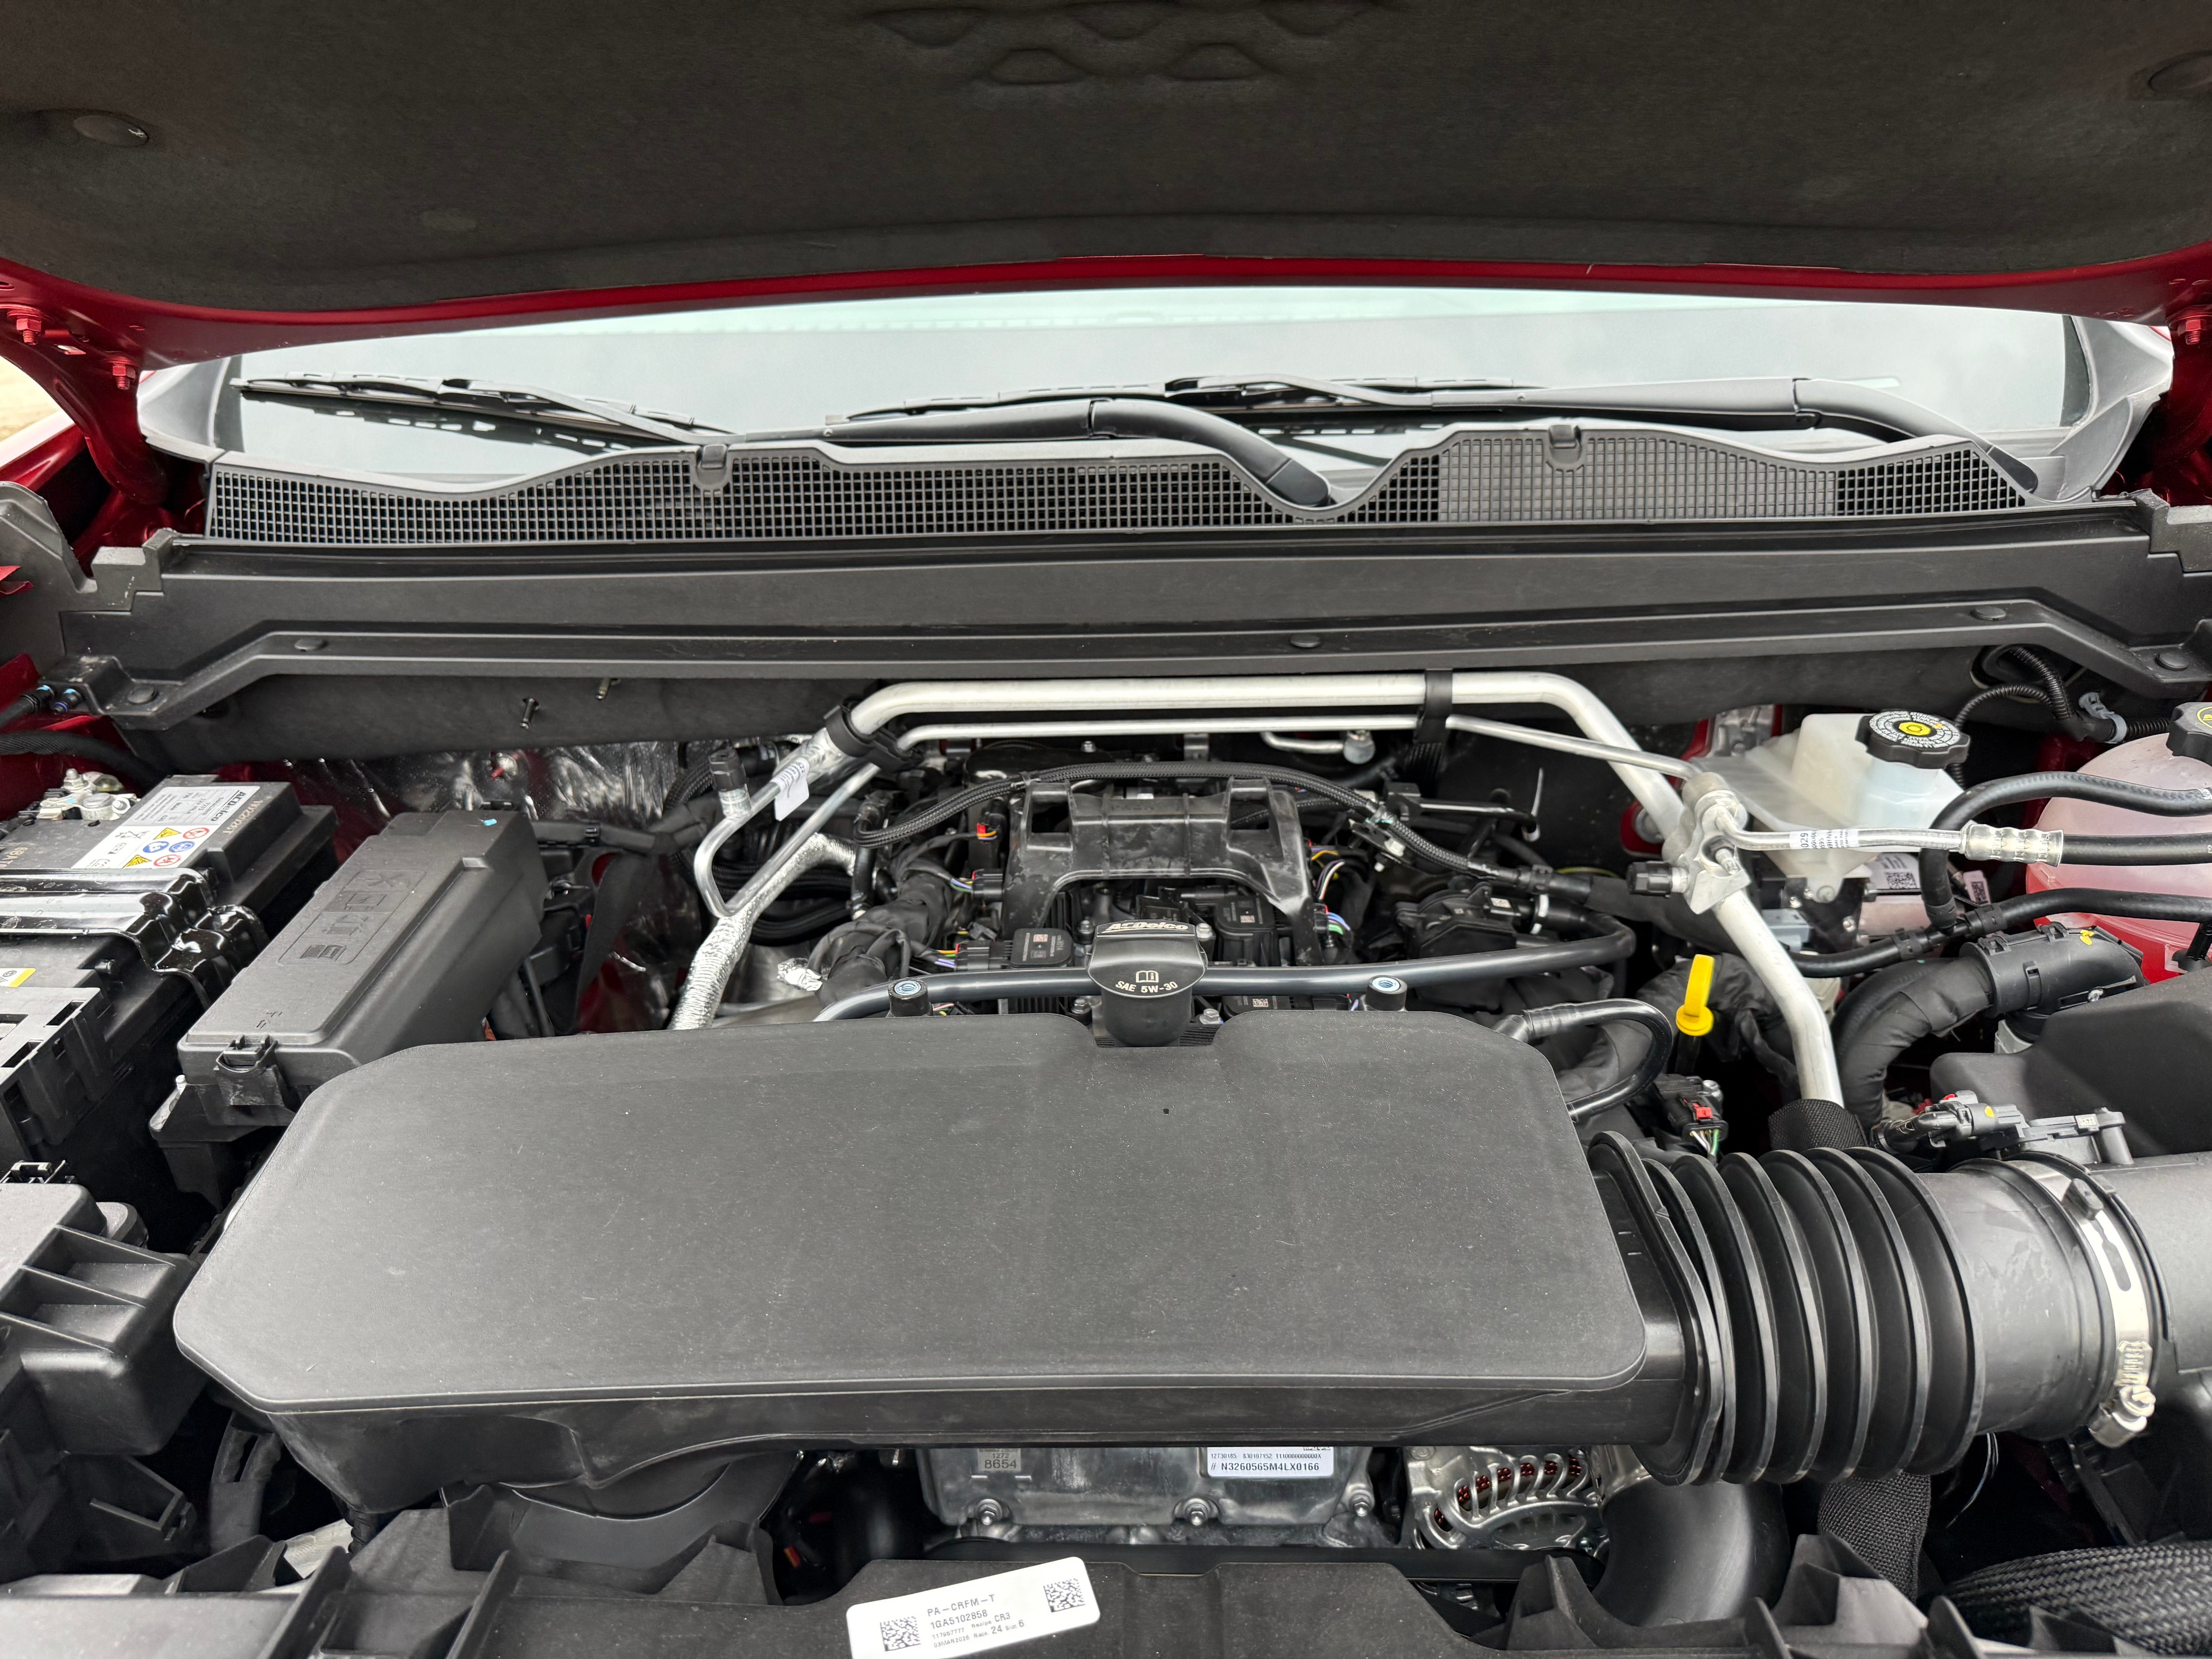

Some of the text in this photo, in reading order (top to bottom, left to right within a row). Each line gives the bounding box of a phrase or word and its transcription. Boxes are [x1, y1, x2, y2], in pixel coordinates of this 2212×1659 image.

[210, 791, 246, 821] ACDelco
[1106, 922, 1188, 931] ACDelco
[1115, 981, 1178, 993] SAE 5W-30
[984, 1459, 1017, 1469] 8654
[1221, 1462, 1320, 1471] N3260565M4LX0166
[930, 1609, 988, 1630] 1GA5102858
[994, 1612, 1011, 1623] CR3
[933, 1635, 970, 1648] 03MAR2026
[991, 1625, 1003, 1635] 24
[1018, 1620, 1025, 1628] 6
